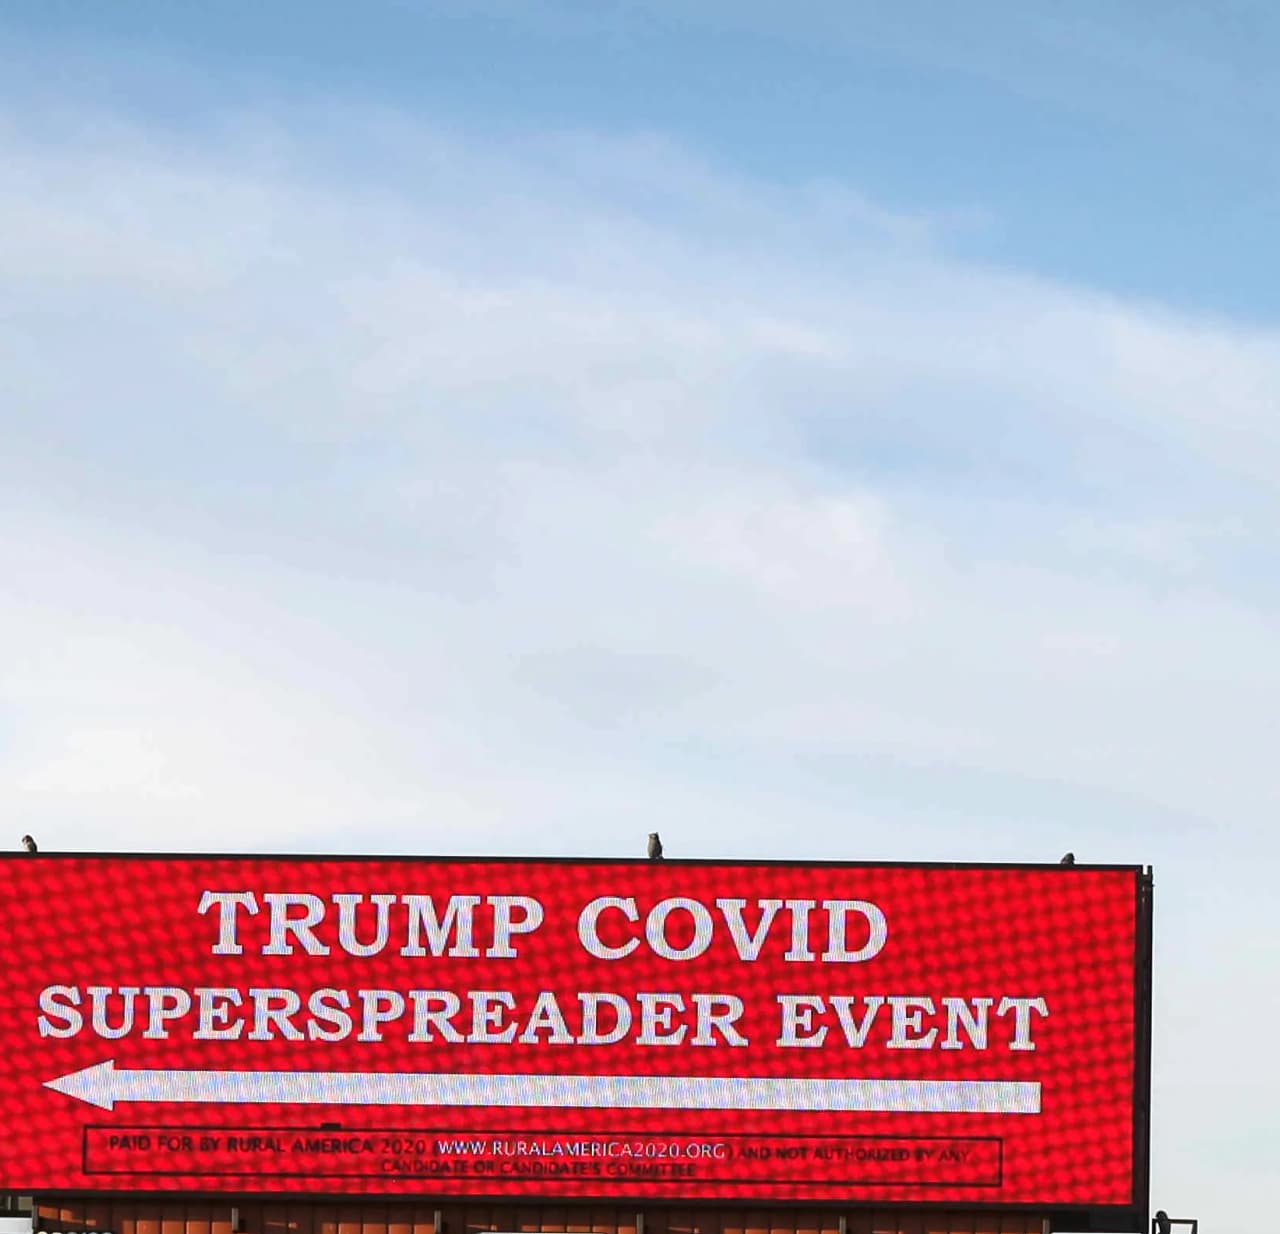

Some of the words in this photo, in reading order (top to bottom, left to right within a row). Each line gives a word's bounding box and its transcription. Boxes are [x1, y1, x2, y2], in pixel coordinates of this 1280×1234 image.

[198, 890, 544, 958] TRUMP
[577, 896, 888, 963] COVID
[37, 985, 748, 1046] SUPERSPREADER
[776, 995, 1048, 1051] EVENT
[109, 1136, 151, 1150] PAID
[158, 1136, 192, 1151] FOR
[200, 1136, 220, 1151] BY
[228, 1137, 285, 1152] RURAL
[291, 1138, 371, 1153] AMERICA
[382, 1139, 425, 1154] 2020
[739, 1147, 769, 1160] AND
[778, 1147, 807, 1161] NOT
[814, 1147, 908, 1162] AUTHORIZED
[383, 1160, 468, 1174] CANDIDATE
[500, 1160, 601, 1176] CANDIDATE'S
